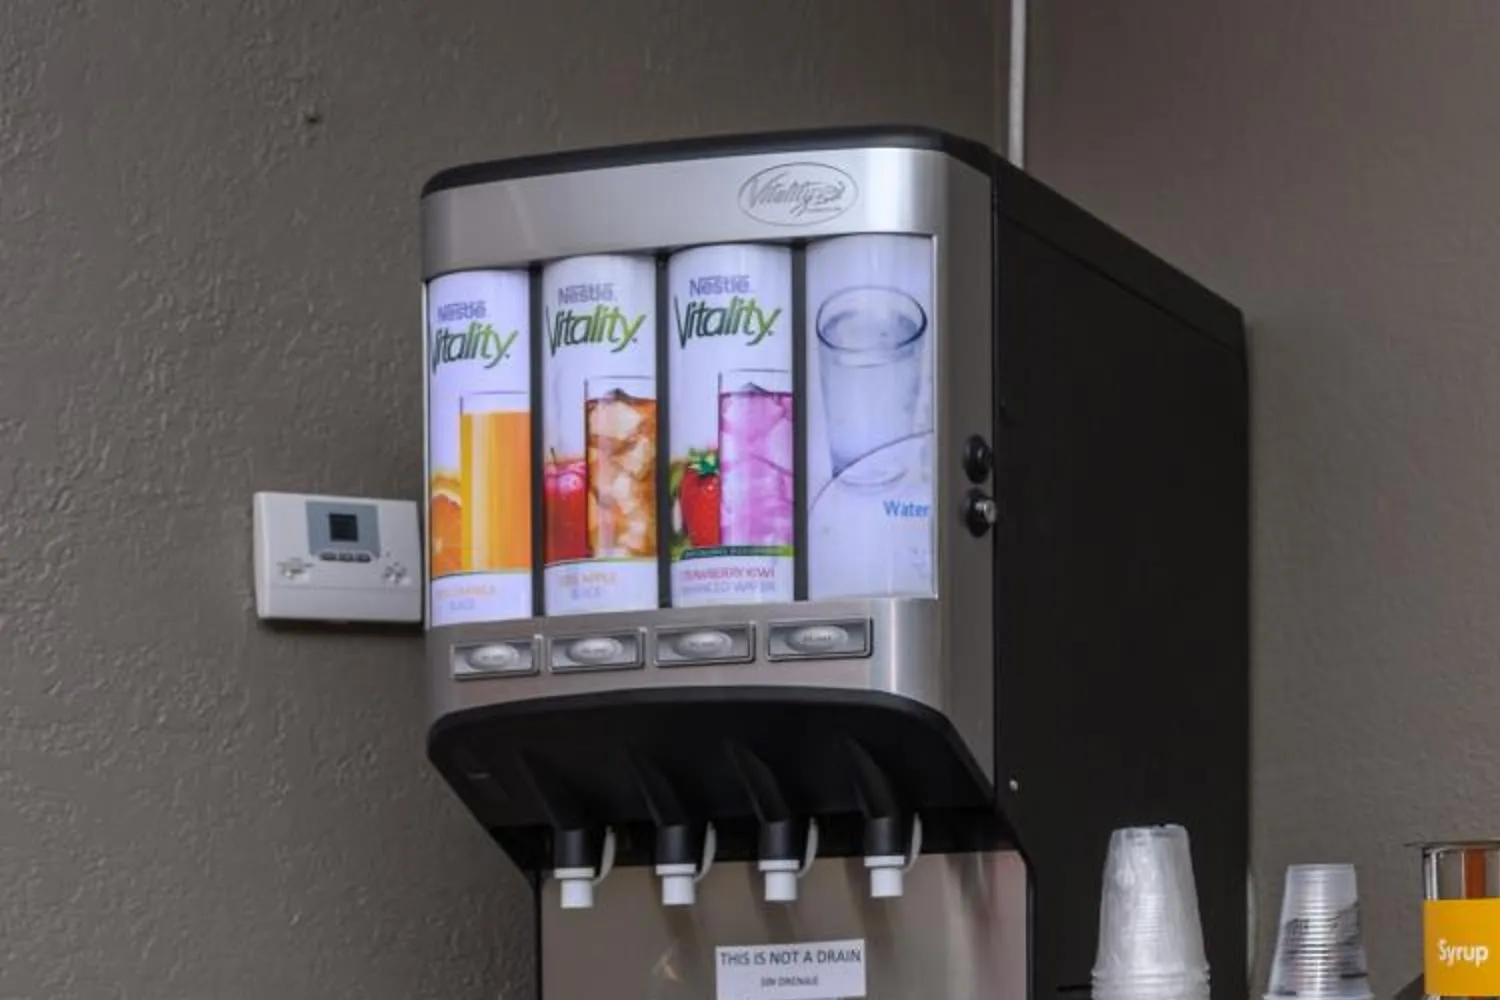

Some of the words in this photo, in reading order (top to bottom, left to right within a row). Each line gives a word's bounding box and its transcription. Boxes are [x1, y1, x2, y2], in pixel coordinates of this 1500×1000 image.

[546, 304, 646, 357] Vitality
[674, 295, 782, 349] Vitality
[882, 499, 930, 517] Water
[721, 951, 750, 966] THIS
[754, 951, 767, 965] IS
[770, 951, 799, 965] NOT
[803, 951, 814, 963] A
[817, 949, 862, 963] DRAIN
[1438, 938, 1489, 966] Syrup
